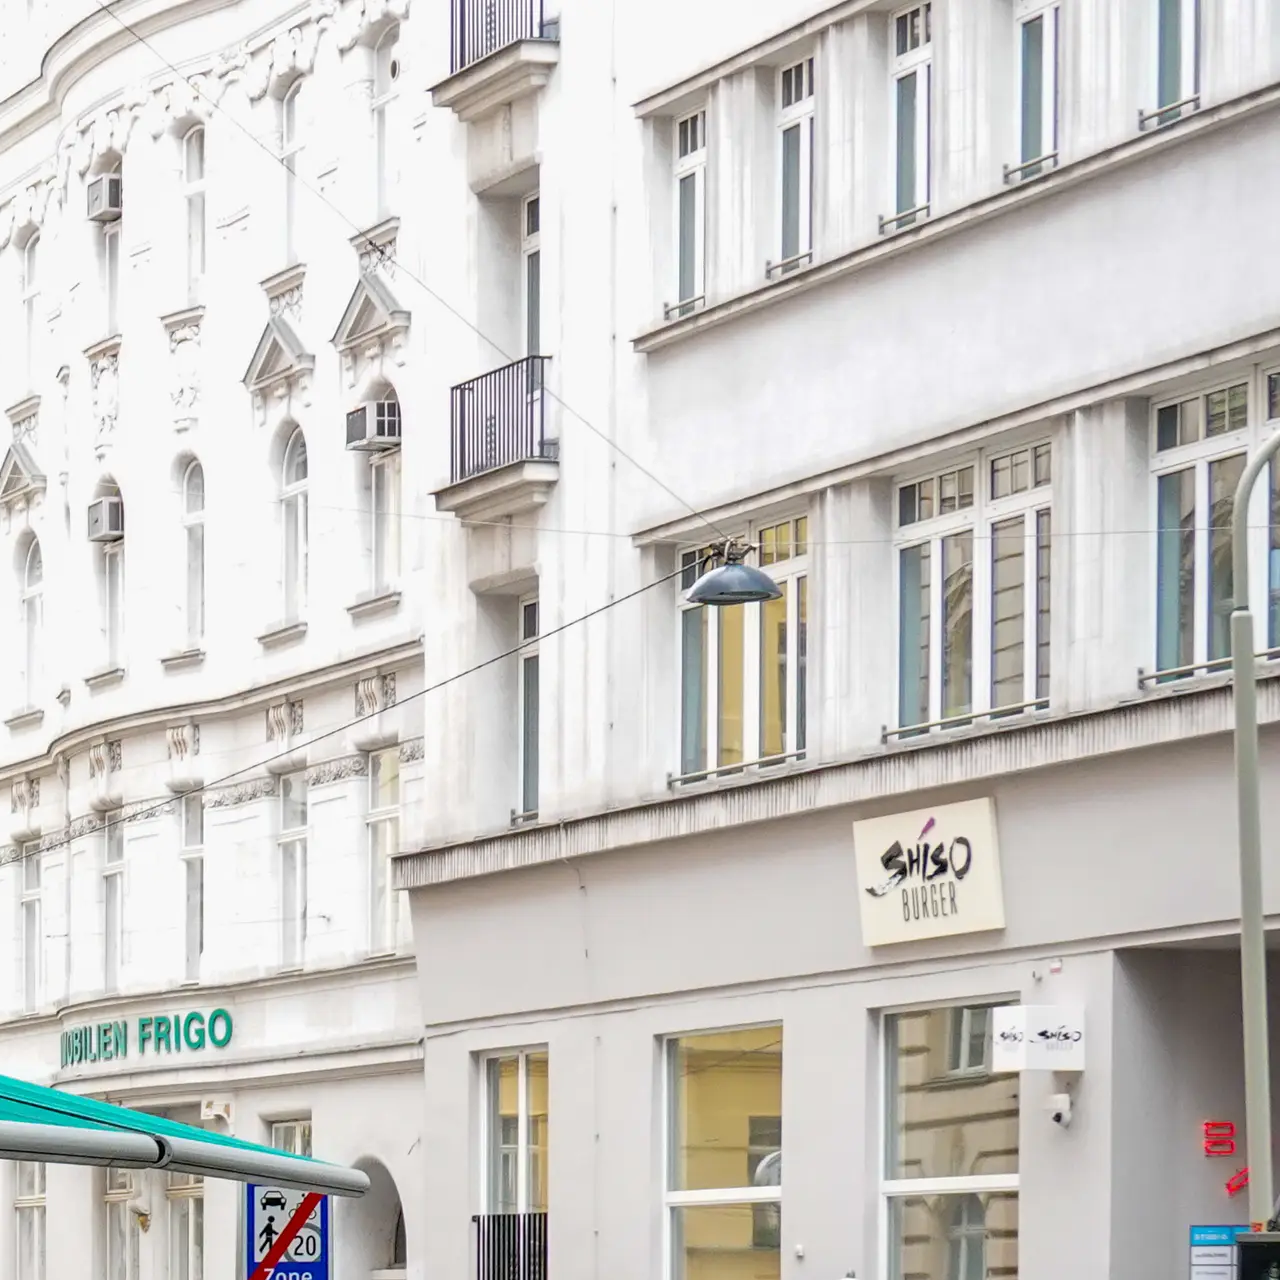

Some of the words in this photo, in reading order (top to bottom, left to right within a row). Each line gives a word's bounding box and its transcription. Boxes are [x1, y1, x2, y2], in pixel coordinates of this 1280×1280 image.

[901, 881, 958, 922] BURGER
[137, 1008, 233, 1055] FRIGO
[293, 1235, 317, 1256] 20
